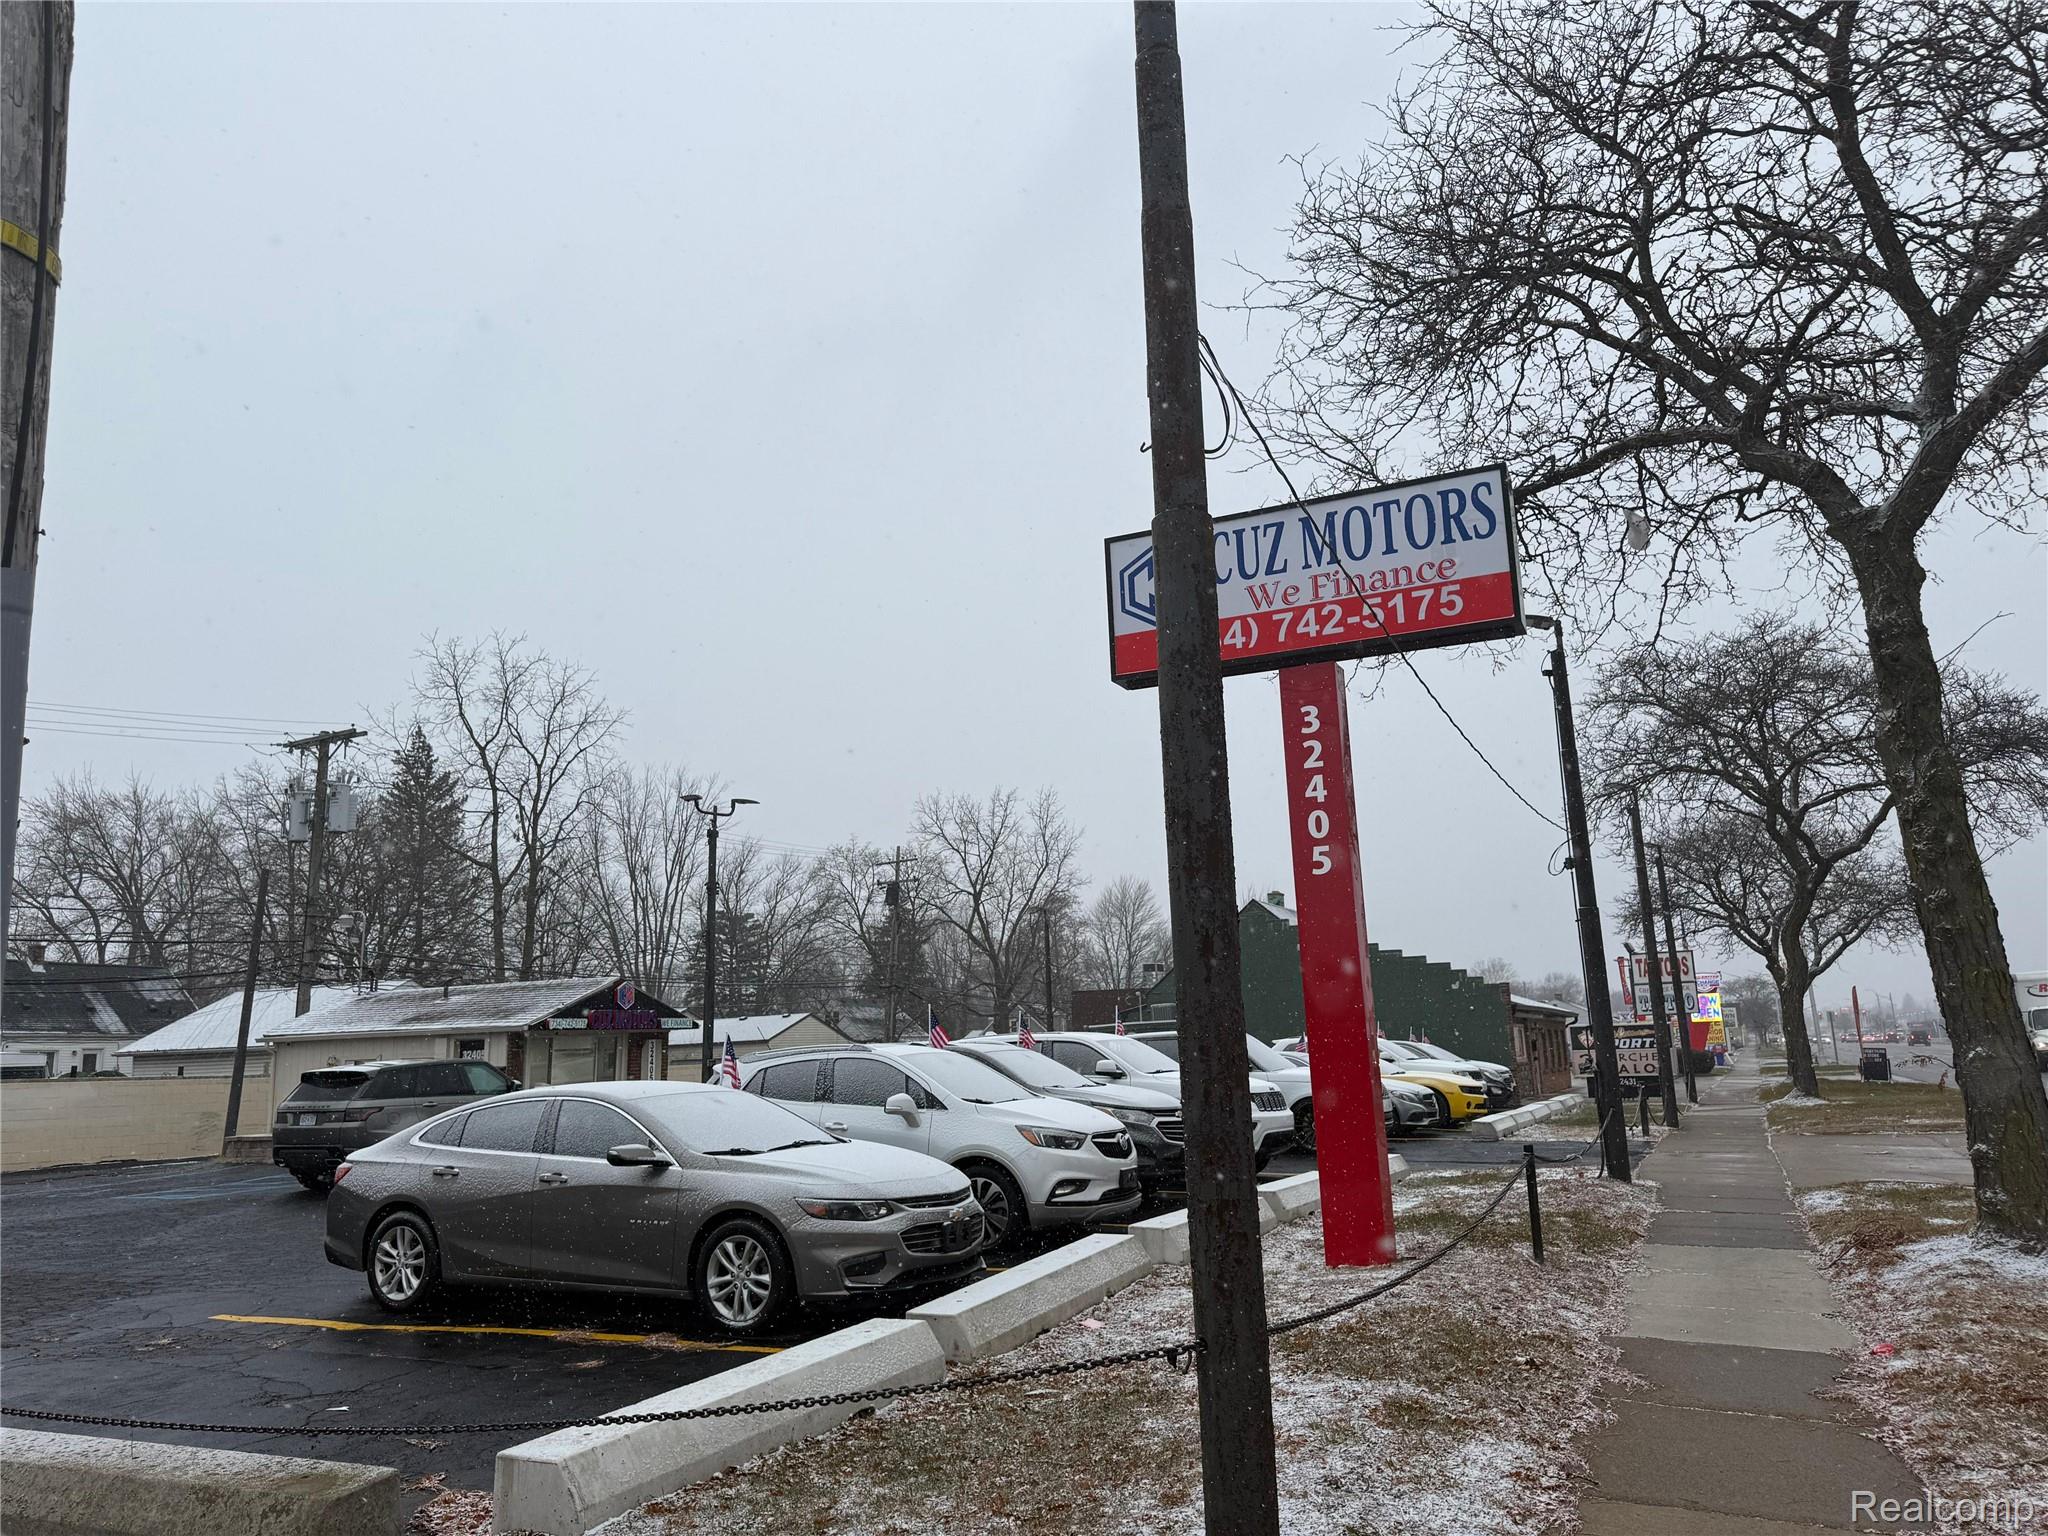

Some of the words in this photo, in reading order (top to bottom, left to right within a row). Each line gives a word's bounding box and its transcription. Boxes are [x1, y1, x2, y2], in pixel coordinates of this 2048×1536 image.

[1298, 481, 1497, 572] MOTORS
[1219, 616, 1259, 650] 4)
[1273, 584, 1464, 643] 742-5175
[1244, 580, 1301, 612] We
[1309, 557, 1457, 601] Finance
[1300, 705, 1333, 877] 32405
[1634, 956, 1690, 978] TATOS
